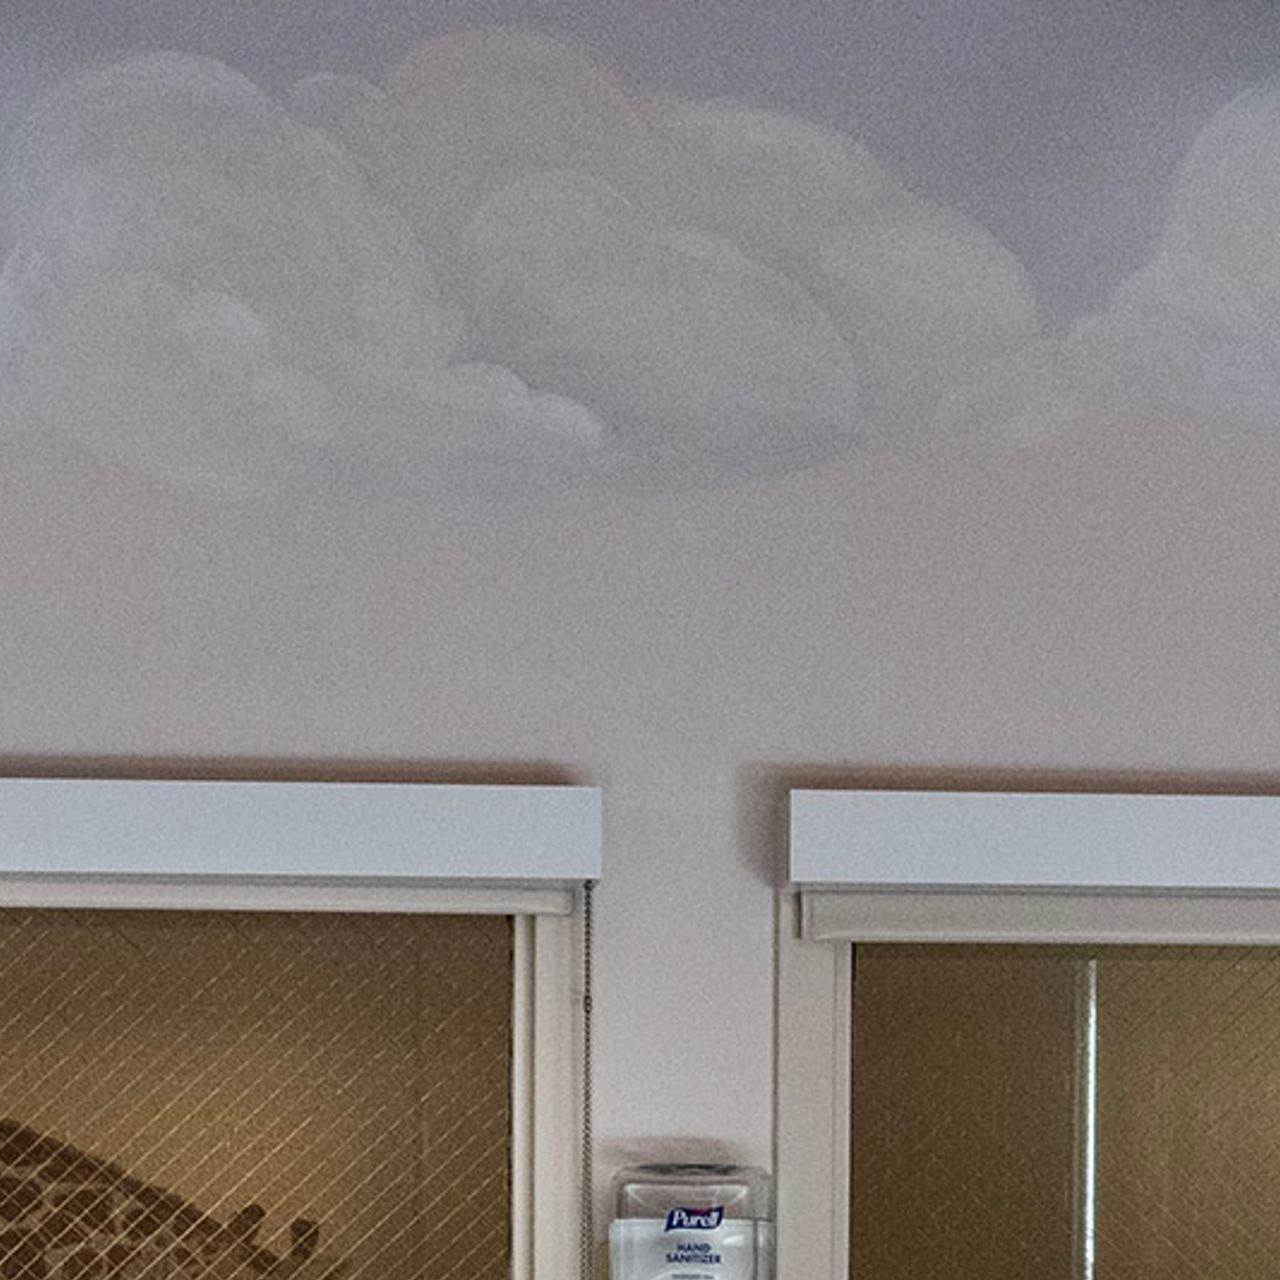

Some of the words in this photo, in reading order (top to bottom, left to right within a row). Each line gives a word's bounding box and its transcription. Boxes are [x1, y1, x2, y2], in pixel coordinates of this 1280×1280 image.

[672, 1209, 720, 1228] Purell
[677, 1243, 711, 1253] HAND
[666, 1253, 721, 1264] SANITIZER
